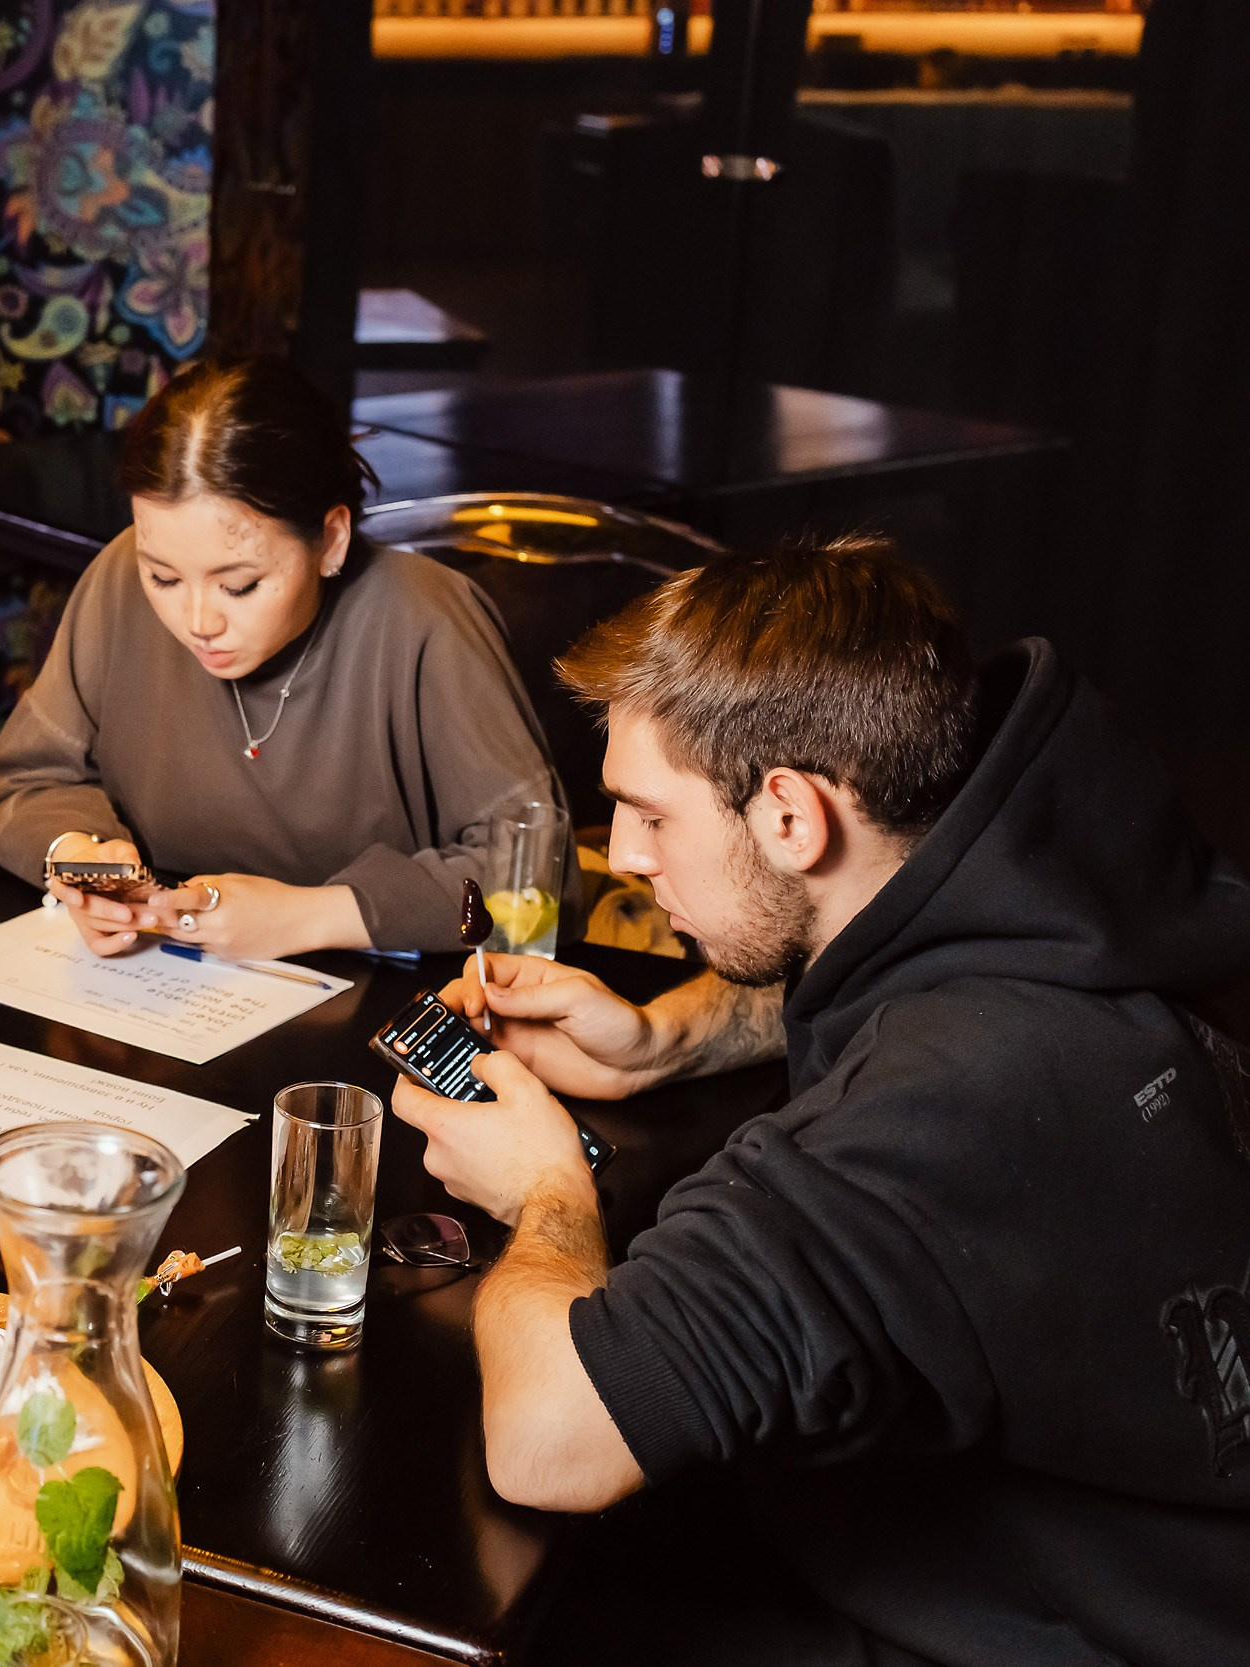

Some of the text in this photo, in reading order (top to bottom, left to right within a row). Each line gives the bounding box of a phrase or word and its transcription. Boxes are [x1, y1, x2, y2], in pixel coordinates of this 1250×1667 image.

[200, 984, 234, 998] Book
[147, 989, 246, 1021] Unthinkable
[242, 998, 267, 1009] The
[186, 1012, 232, 1027] Joker
[1133, 1068, 1176, 1107] ESTD
